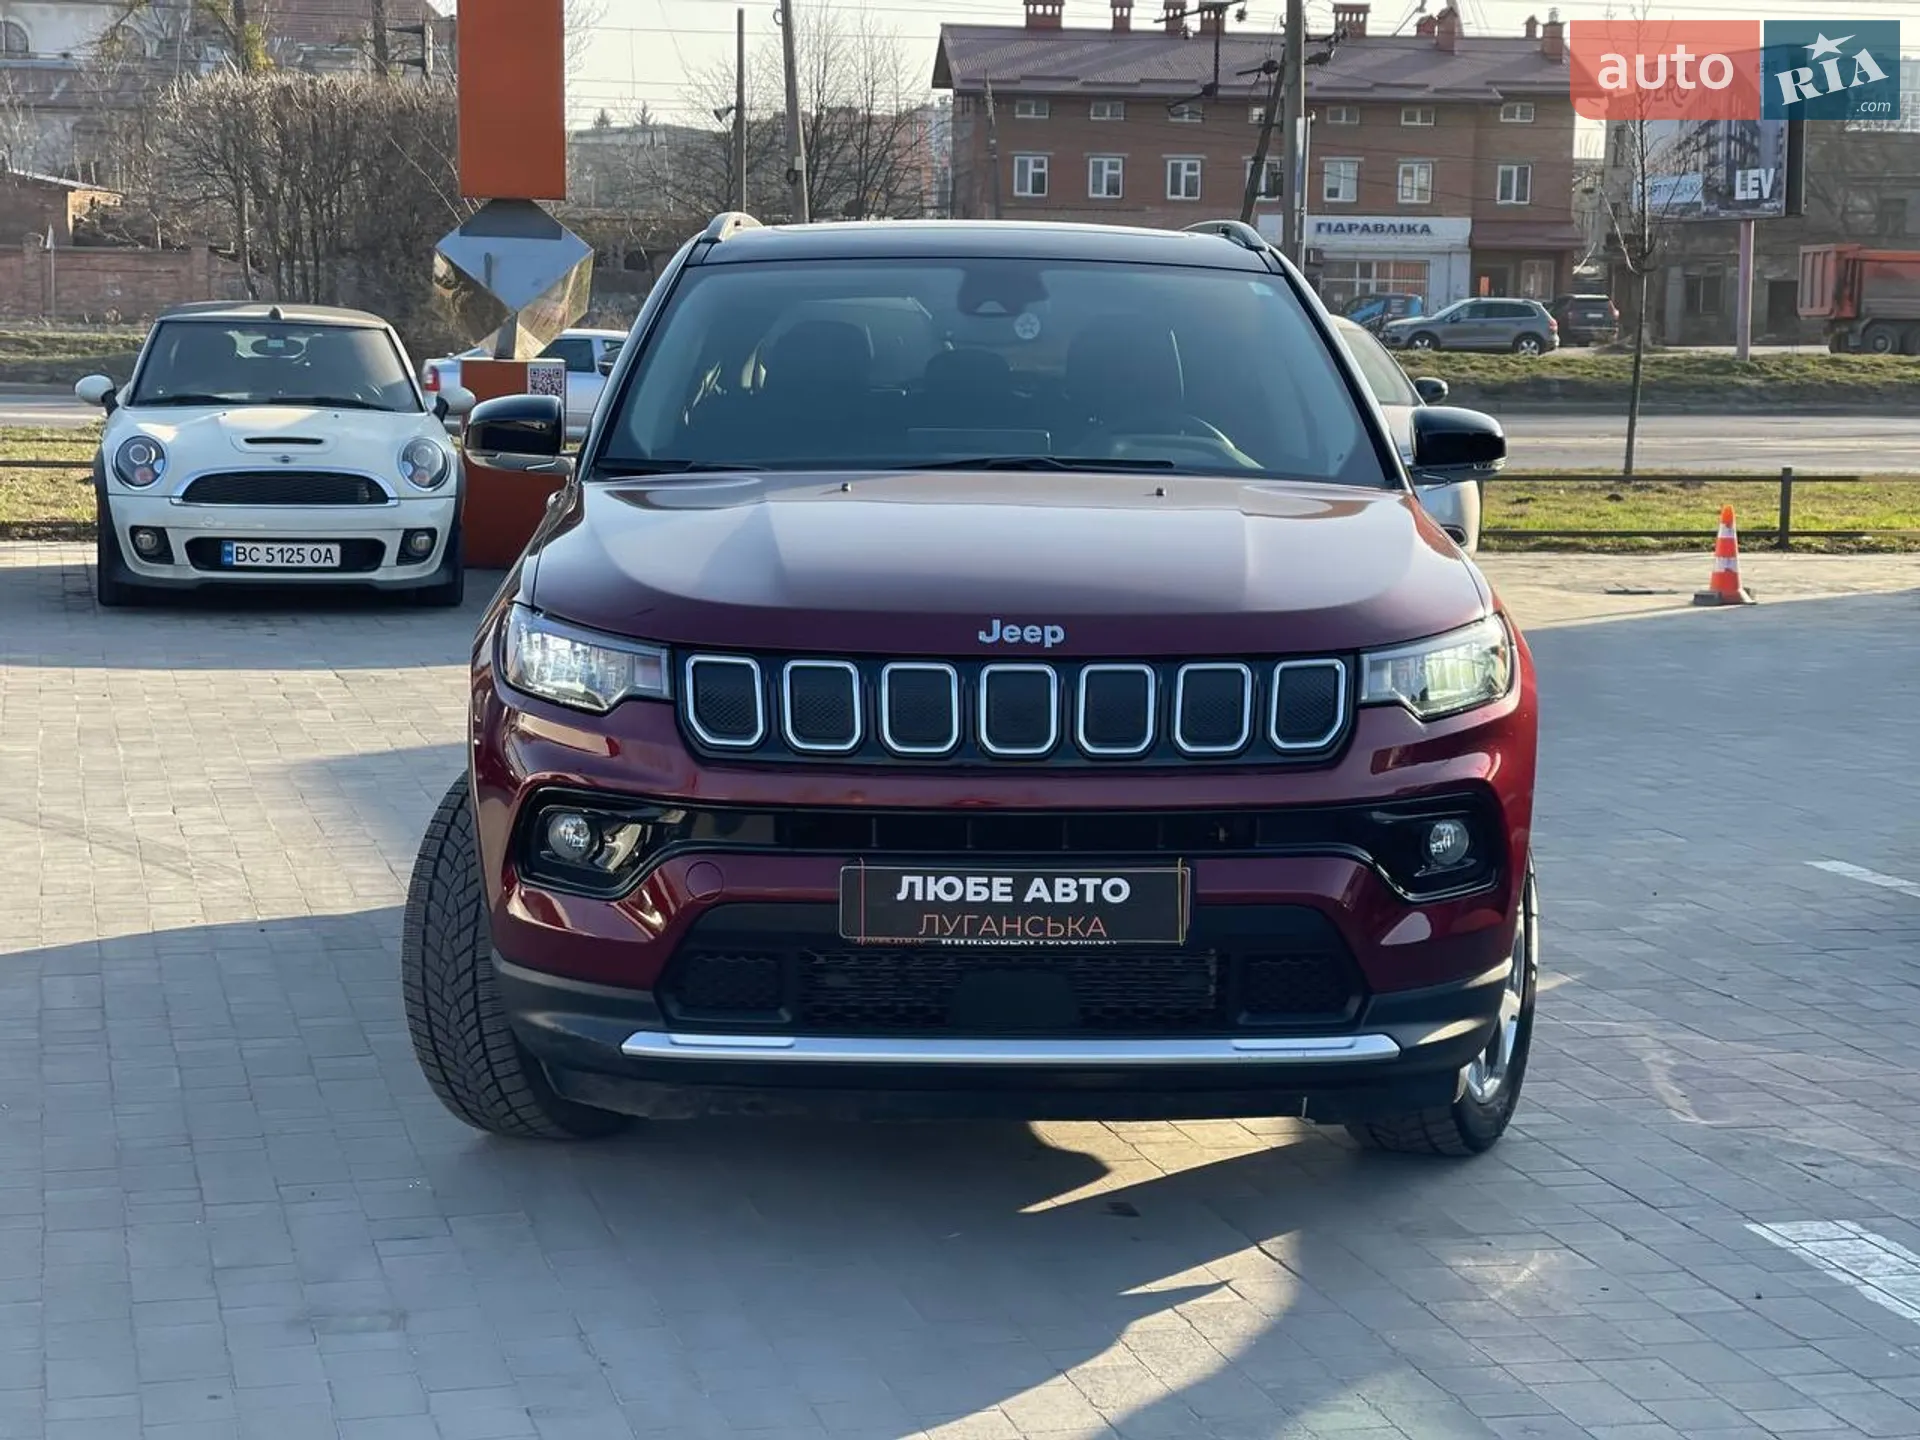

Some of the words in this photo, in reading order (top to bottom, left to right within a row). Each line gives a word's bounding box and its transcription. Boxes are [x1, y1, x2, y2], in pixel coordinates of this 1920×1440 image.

[1735, 168, 1775, 200] LEV
[1315, 221, 1432, 236] ГІДРАВЛІКА
[265, 546, 306, 564] 5125
[978, 619, 1065, 648] Jeep
[896, 875, 1013, 903] ЛЮБЕ
[1023, 877, 1131, 904] АВТО
[918, 914, 1108, 938] ЛУГАНСЬКА
